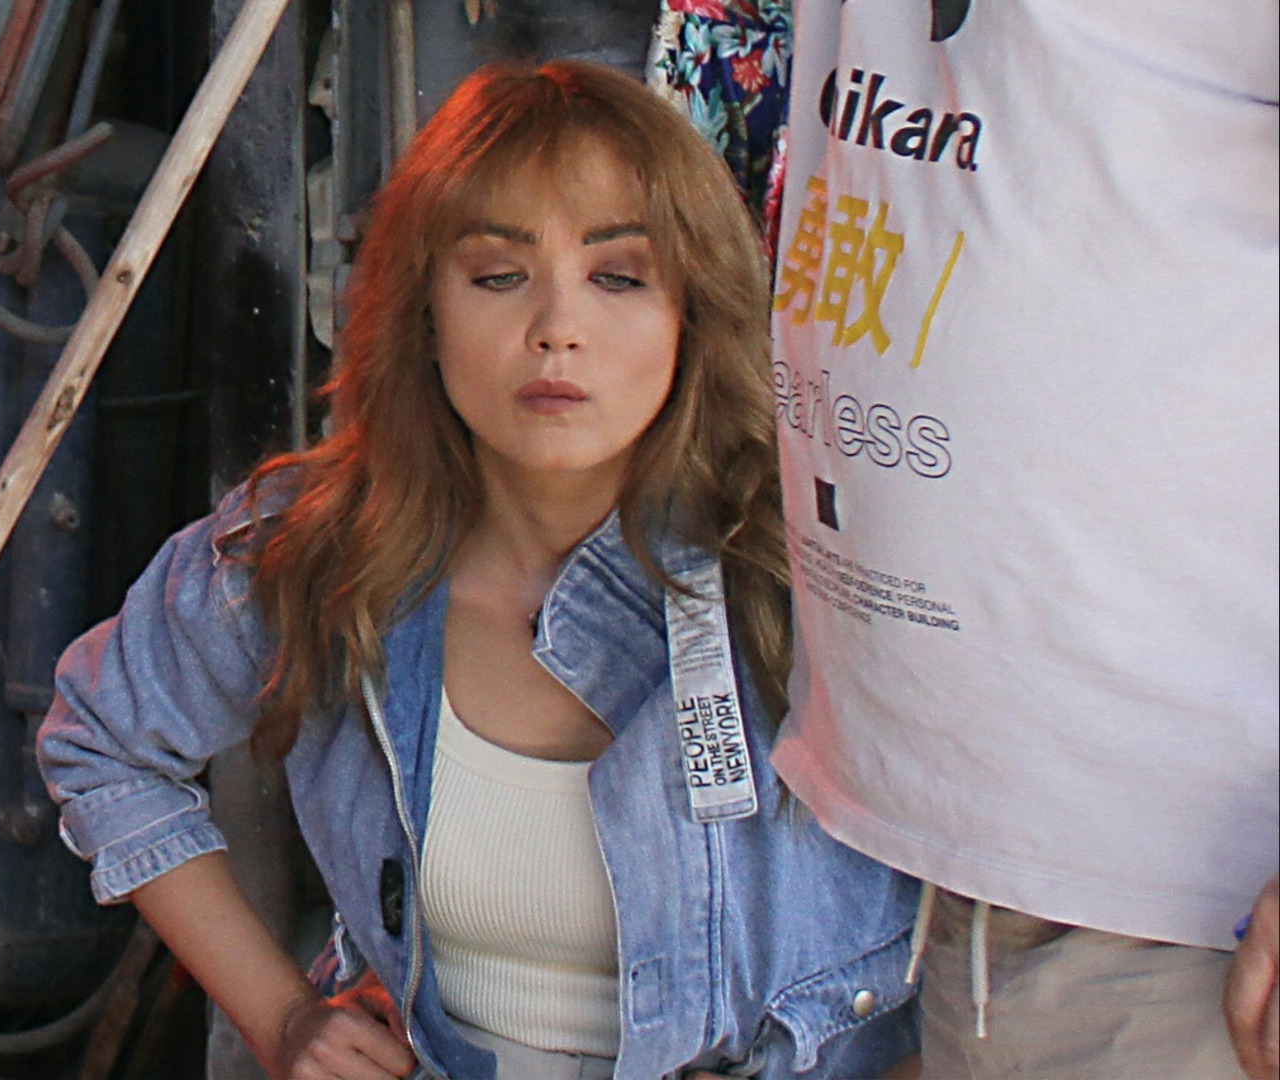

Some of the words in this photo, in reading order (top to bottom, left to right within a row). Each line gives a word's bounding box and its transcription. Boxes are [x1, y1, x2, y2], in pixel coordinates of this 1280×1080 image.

[772, 360, 952, 479] earless
[903, 578, 926, 593] FOR
[896, 593, 958, 615] PERSONAL
[907, 609, 961, 632] BUILDING
[696, 695, 717, 742] STREET
[678, 696, 712, 788] PEOPLE
[708, 742, 723, 767] THE
[713, 767, 727, 786] ON
